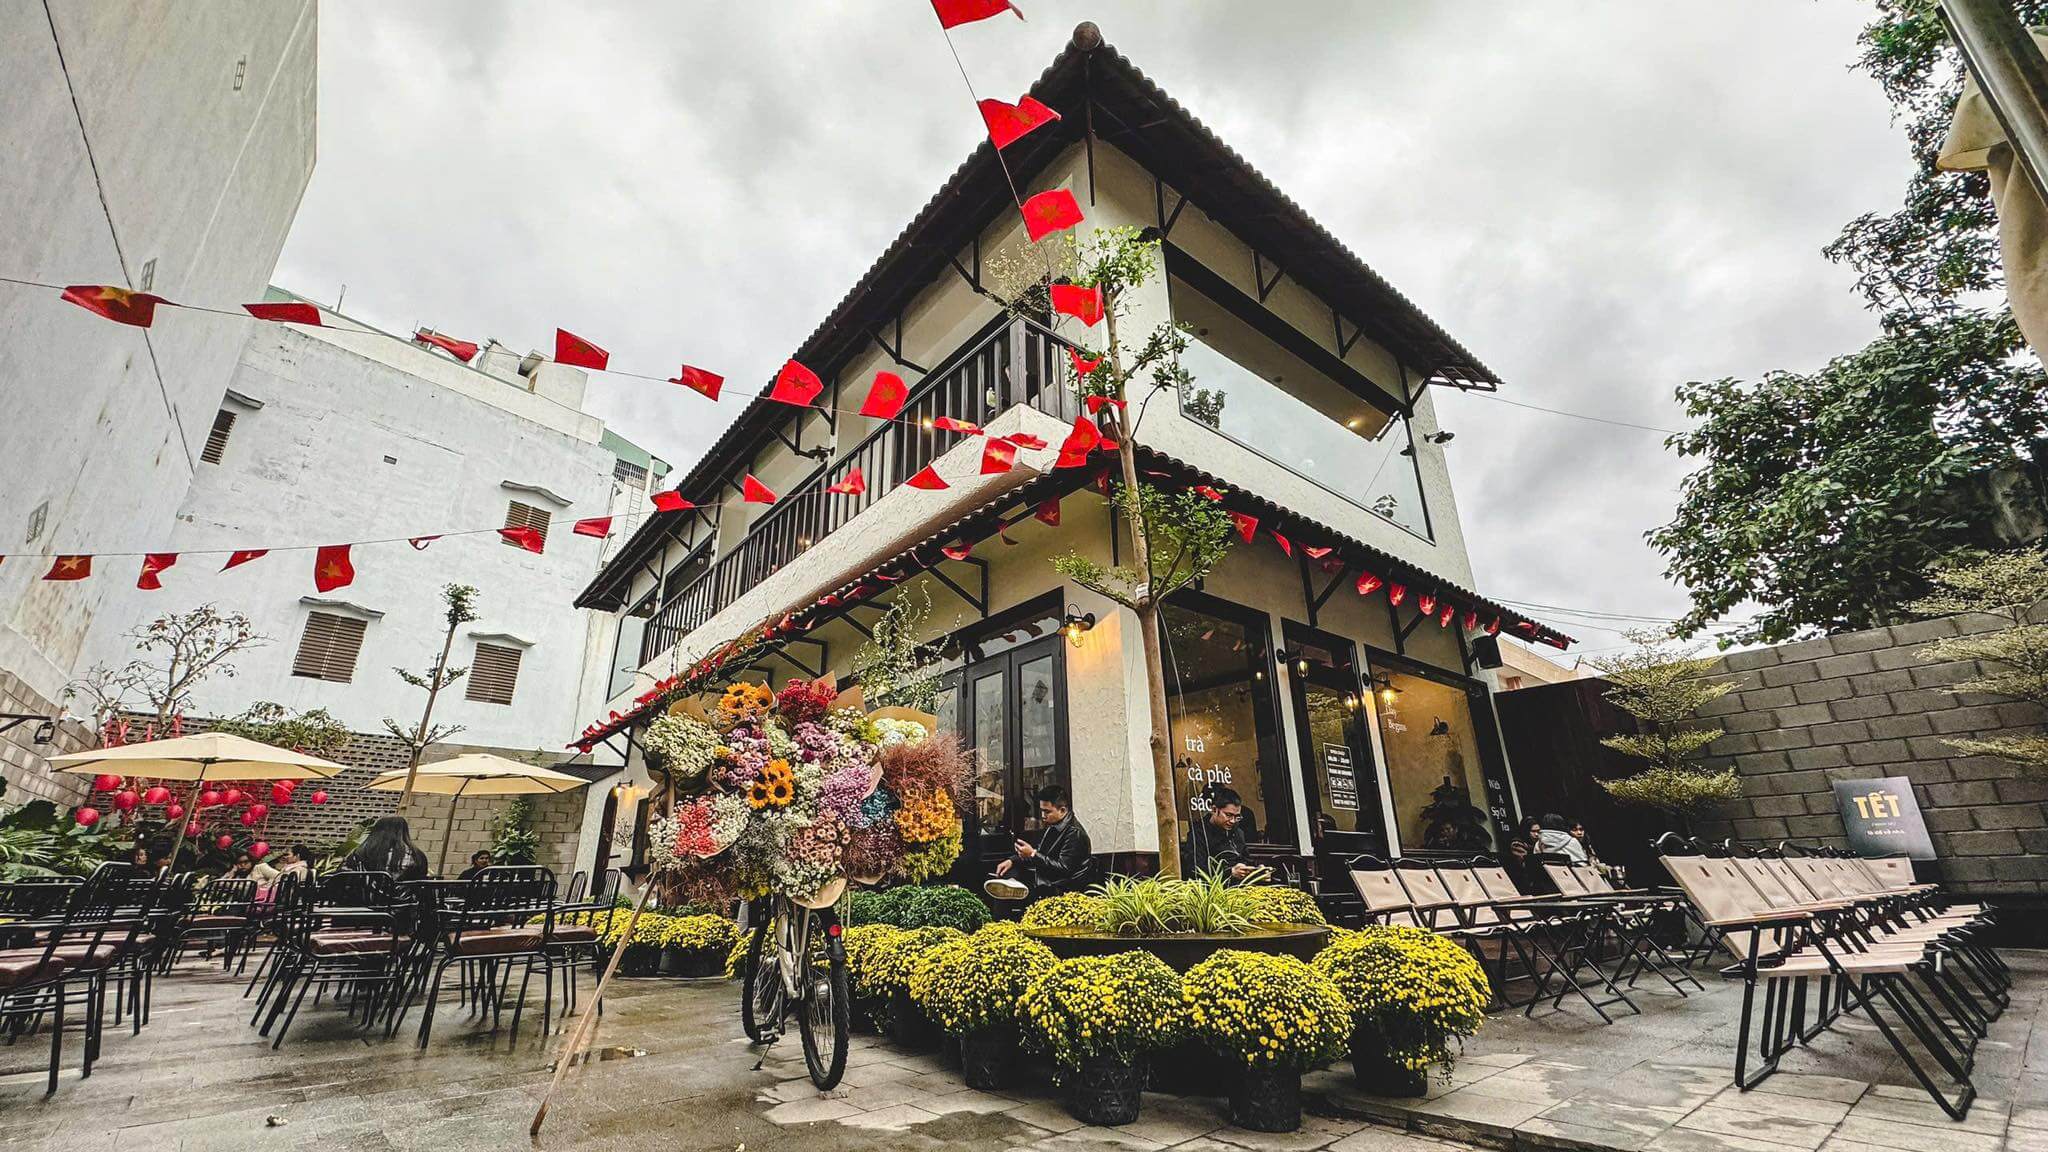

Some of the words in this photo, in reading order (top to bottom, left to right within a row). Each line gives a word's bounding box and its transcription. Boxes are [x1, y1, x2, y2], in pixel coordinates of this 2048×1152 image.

[1185, 735, 1205, 753] trà
[1187, 763, 1204, 782] cà
[1206, 764, 1232, 788] phê
[1190, 792, 1215, 812] sác
[1852, 790, 1901, 819] TẾT
